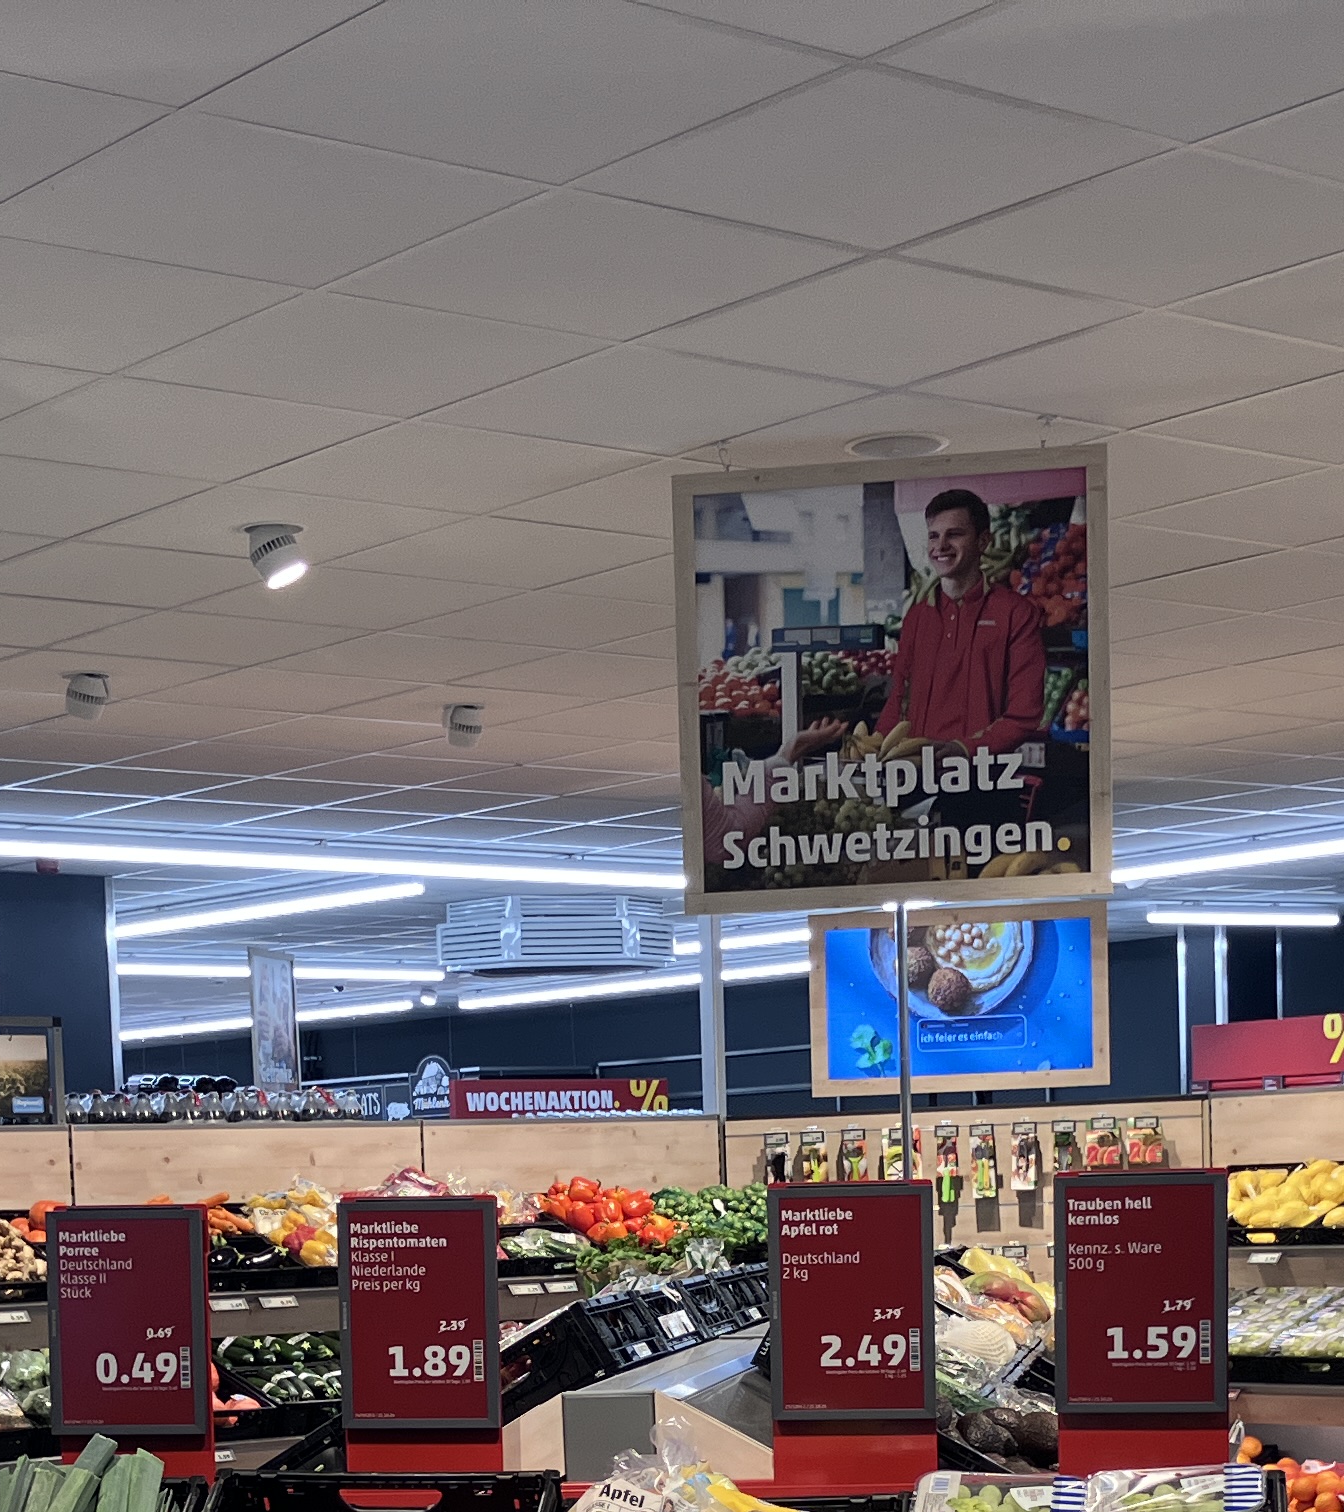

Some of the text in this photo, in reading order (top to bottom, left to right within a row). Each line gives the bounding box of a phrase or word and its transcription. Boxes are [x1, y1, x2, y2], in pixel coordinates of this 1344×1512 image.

[721, 746, 1024, 806] Marktplatz
[722, 815, 1071, 870] Schwetzingen.
[466, 1089, 620, 1113] WOCHENAKTION.
[1067, 1196, 1153, 1211] Trauben hell
[781, 1207, 853, 1222] Marktliebe
[1067, 1212, 1120, 1226] kernlos
[350, 1221, 419, 1235] Marktliebe
[781, 1222, 839, 1238] Apfel rot
[58, 1230, 126, 1243] Marktliebe
[350, 1236, 448, 1250] Rispentomaten
[58, 1245, 99, 1257] Porree
[1068, 1242, 1162, 1255] Kennz. s. Ware
[59, 1258, 133, 1271] Deutschland
[351, 1251, 395, 1263] Klasse I
[782, 1251, 860, 1265] Deutschland
[1068, 1257, 1105, 1272] 500 g
[351, 1264, 426, 1277] Niederlande
[782, 1267, 809, 1282] 2 kg
[60, 1273, 107, 1285] Klasse II
[352, 1278, 421, 1293] Preis per kg
[60, 1286, 92, 1299] Stück
[1106, 1325, 1197, 1360] 1.59
[820, 1333, 907, 1368] 2.49
[95, 1351, 178, 1385] 0.49
[388, 1345, 471, 1378] 1.89
